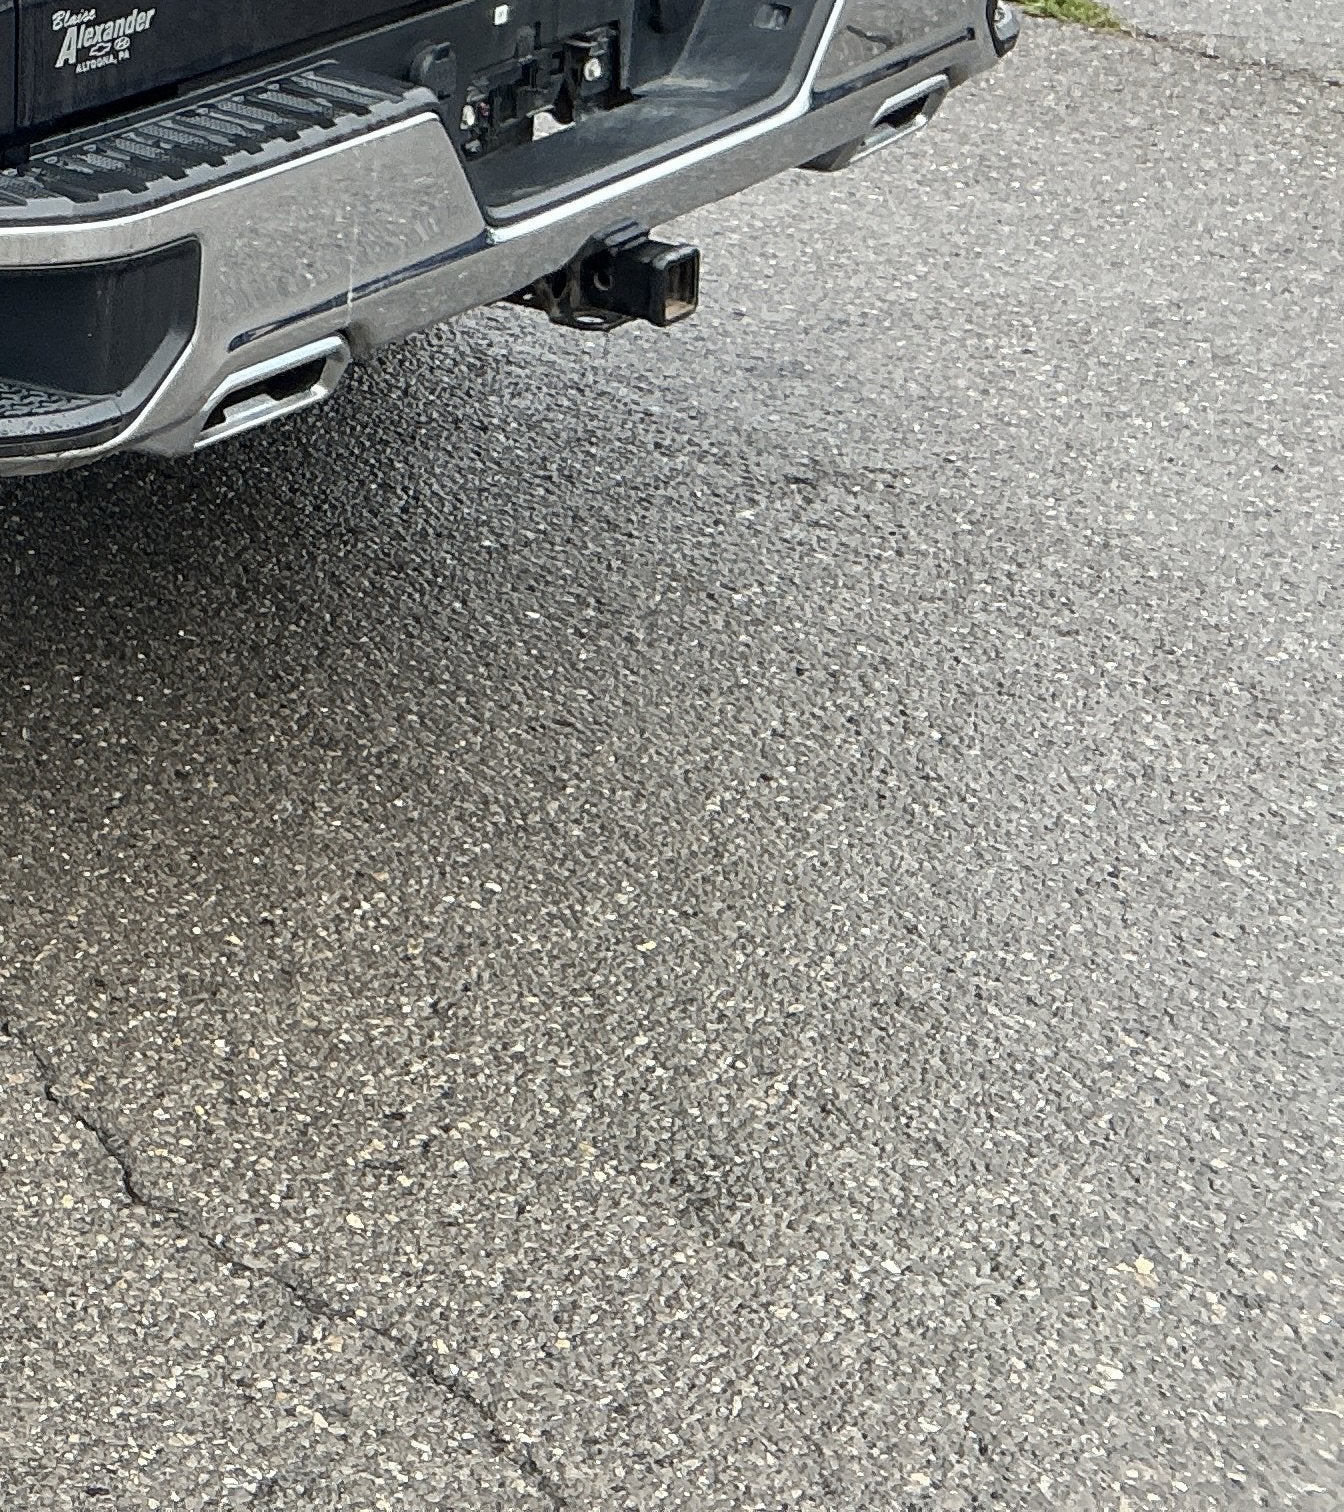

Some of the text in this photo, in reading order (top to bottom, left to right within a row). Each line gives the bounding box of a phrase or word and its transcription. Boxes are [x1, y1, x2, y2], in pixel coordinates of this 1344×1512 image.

[52, 8, 96, 31] Blaise
[54, 8, 156, 68] Alexander
[118, 49, 130, 60] PA
